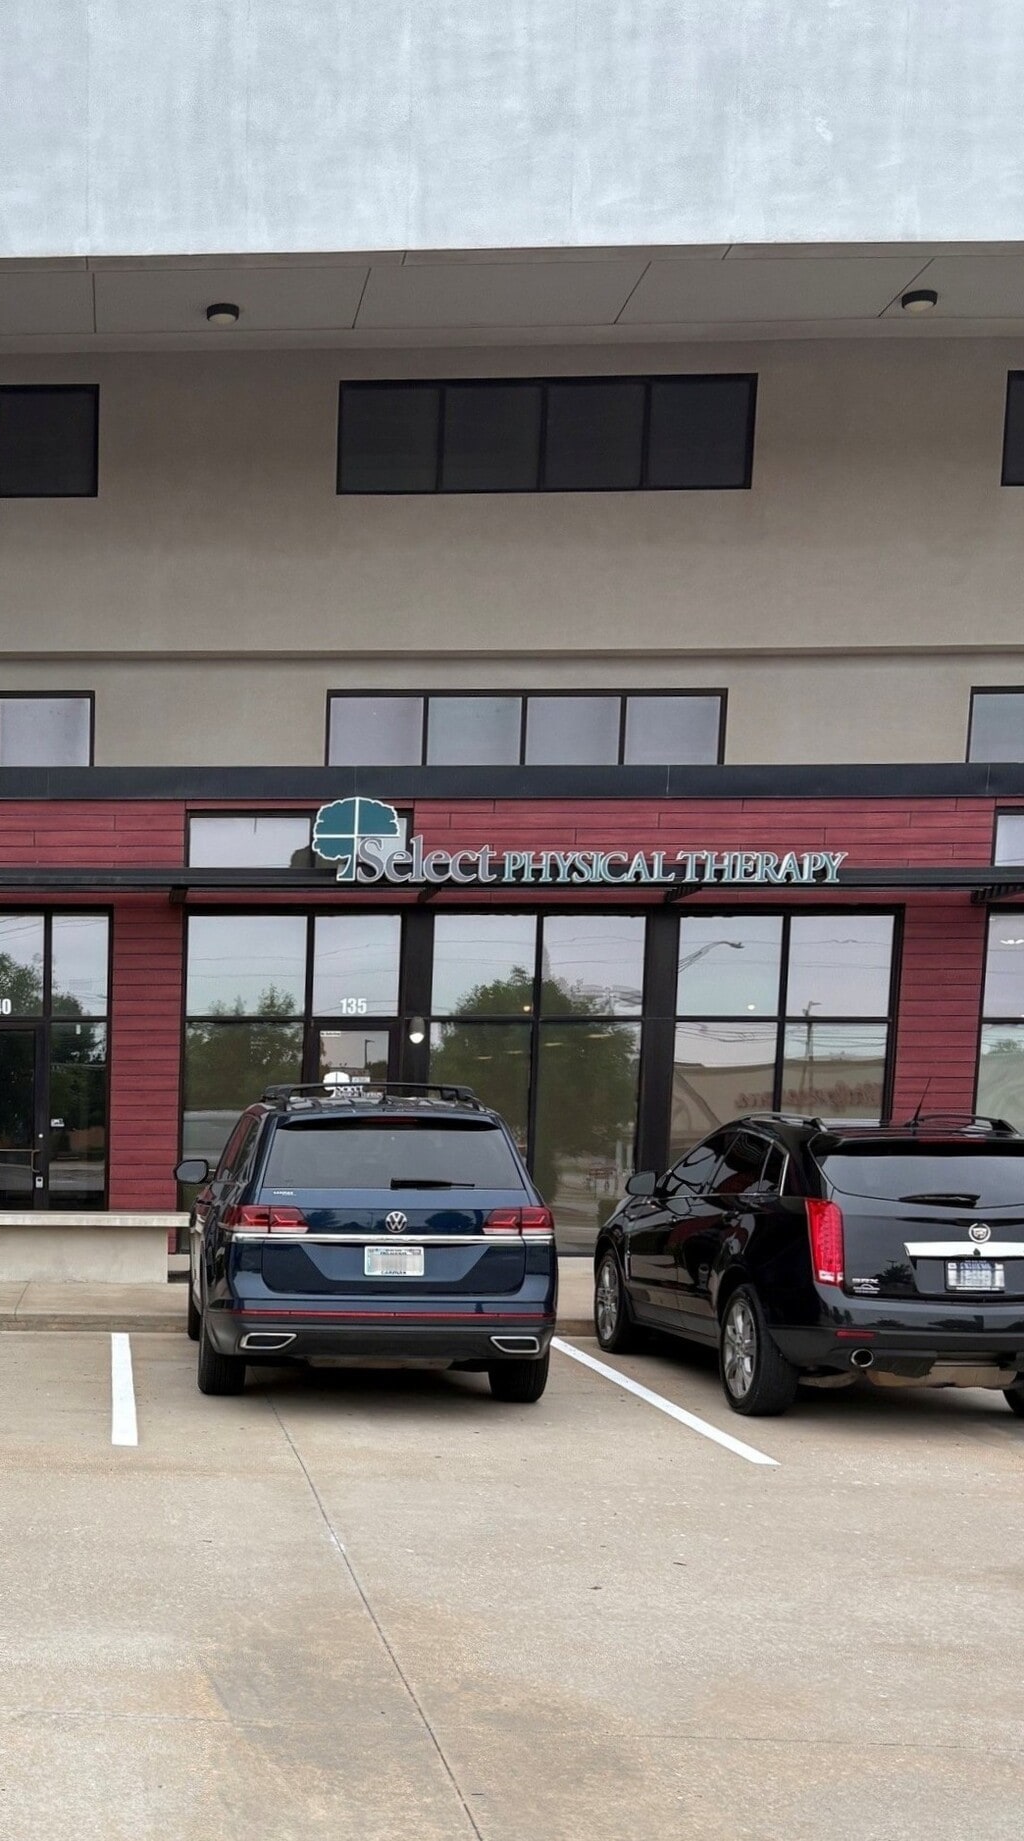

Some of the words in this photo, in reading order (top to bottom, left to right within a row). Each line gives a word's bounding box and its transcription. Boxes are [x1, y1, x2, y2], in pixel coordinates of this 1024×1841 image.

[356, 834, 497, 884] Select
[501, 850, 676, 884] PHYSICAL
[676, 850, 849, 884] THERAPY
[340, 998, 368, 1014] 135
